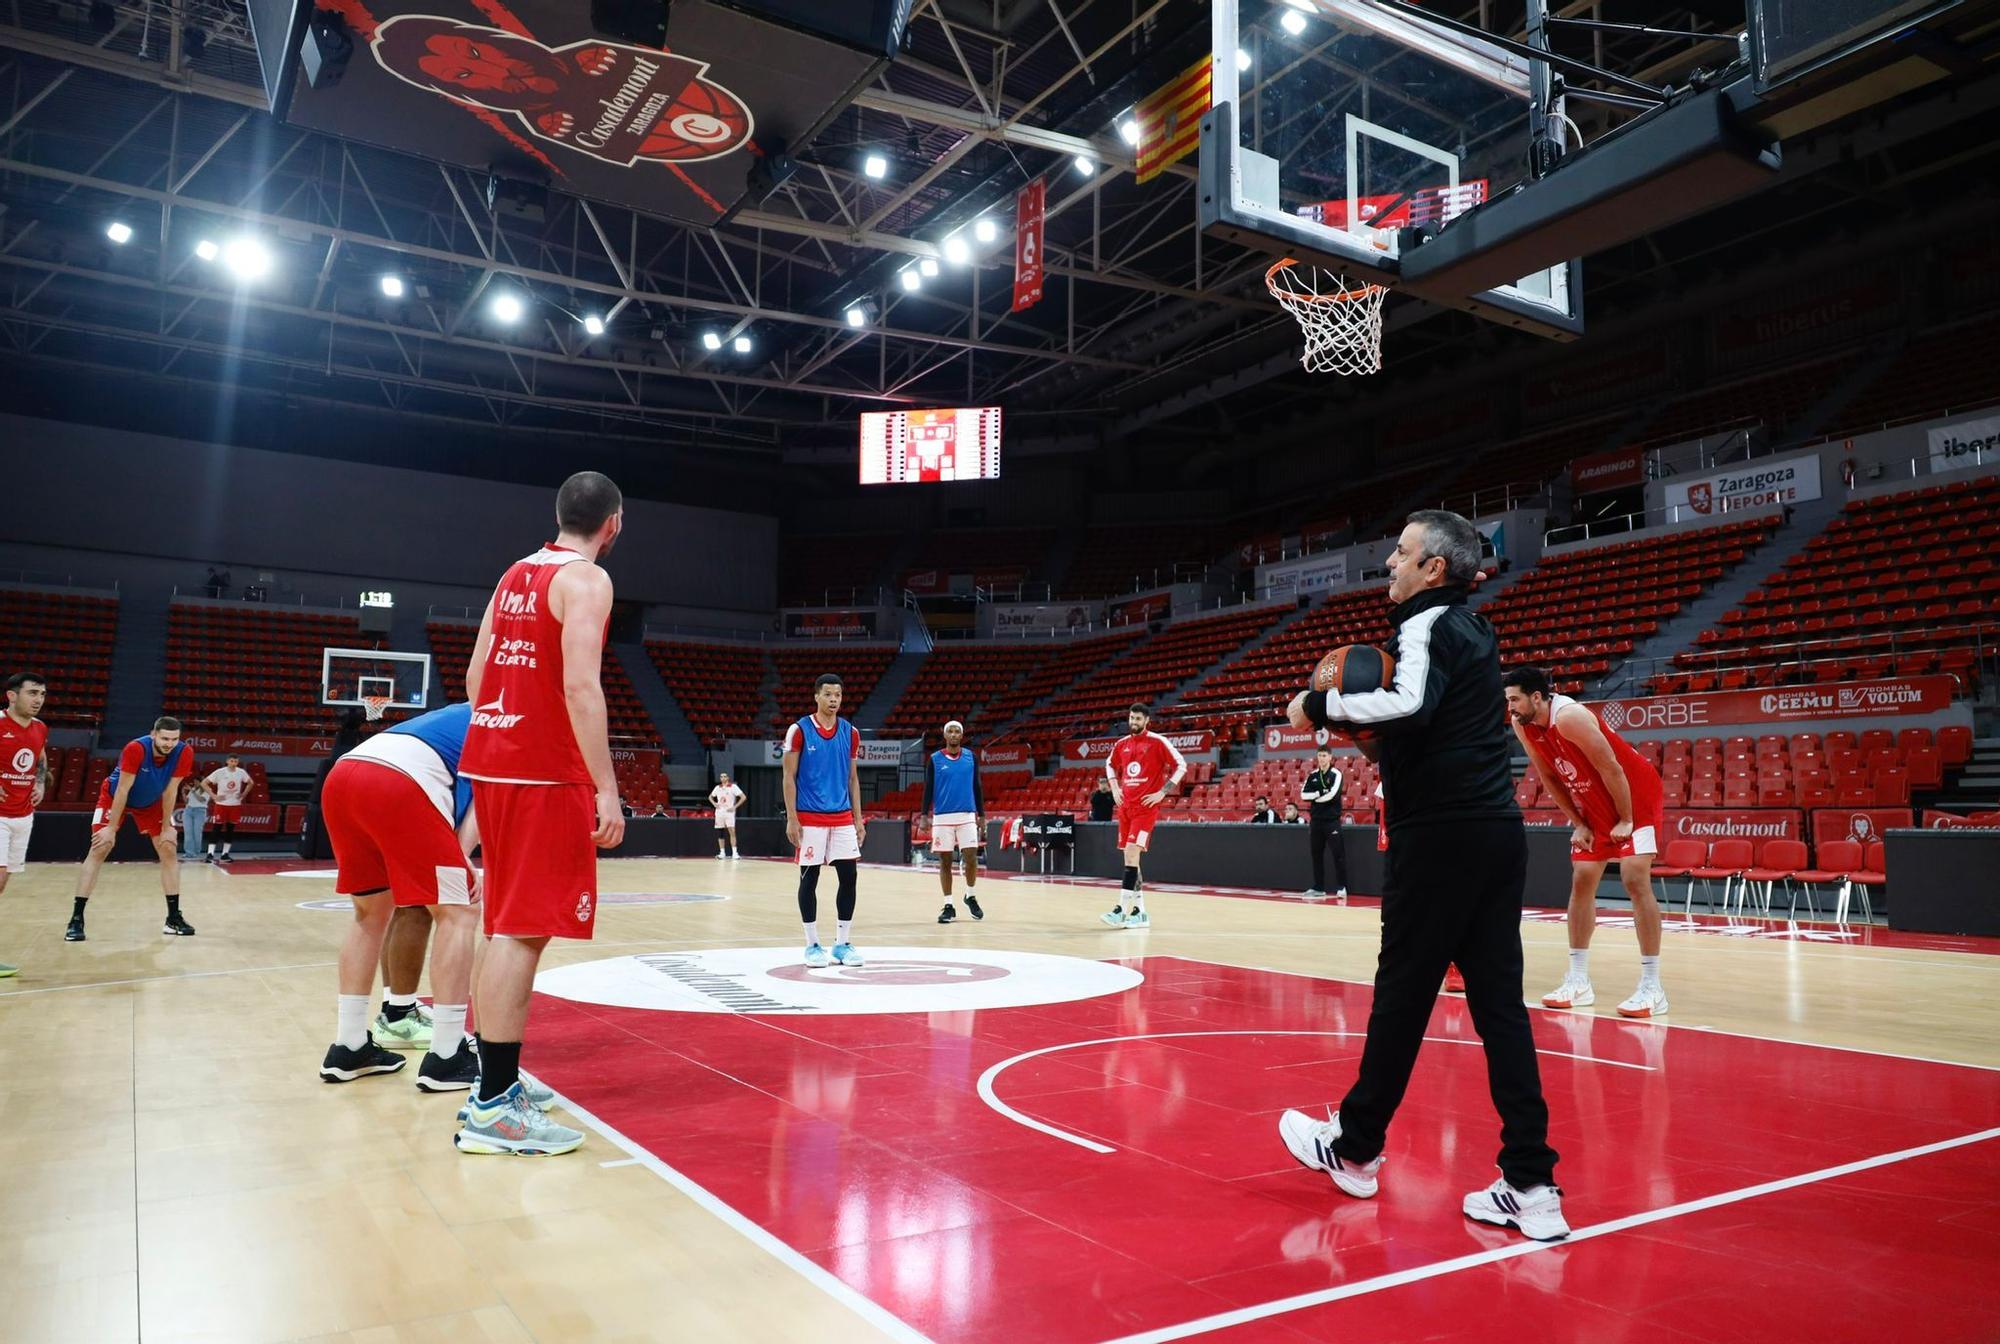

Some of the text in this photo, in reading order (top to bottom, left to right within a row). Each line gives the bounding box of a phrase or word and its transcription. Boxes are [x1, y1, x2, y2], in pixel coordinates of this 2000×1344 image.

[575, 56, 660, 148] Casademont
[625, 92, 670, 136] ZARAGOZA
[1943, 433, 2000, 458] iber
[1719, 467, 1795, 493] Zaragoza
[1719, 487, 1795, 512] DEPORTE
[1867, 690, 1922, 704] VOLUM
[1626, 702, 1709, 728] ORBE
[185, 736, 216, 747] alsa
[868, 744, 900, 753] Zaragoza
[1282, 734, 1312, 744] Inycom
[1678, 816, 1787, 837] Casademont
[633, 954, 820, 1013] Casademont
